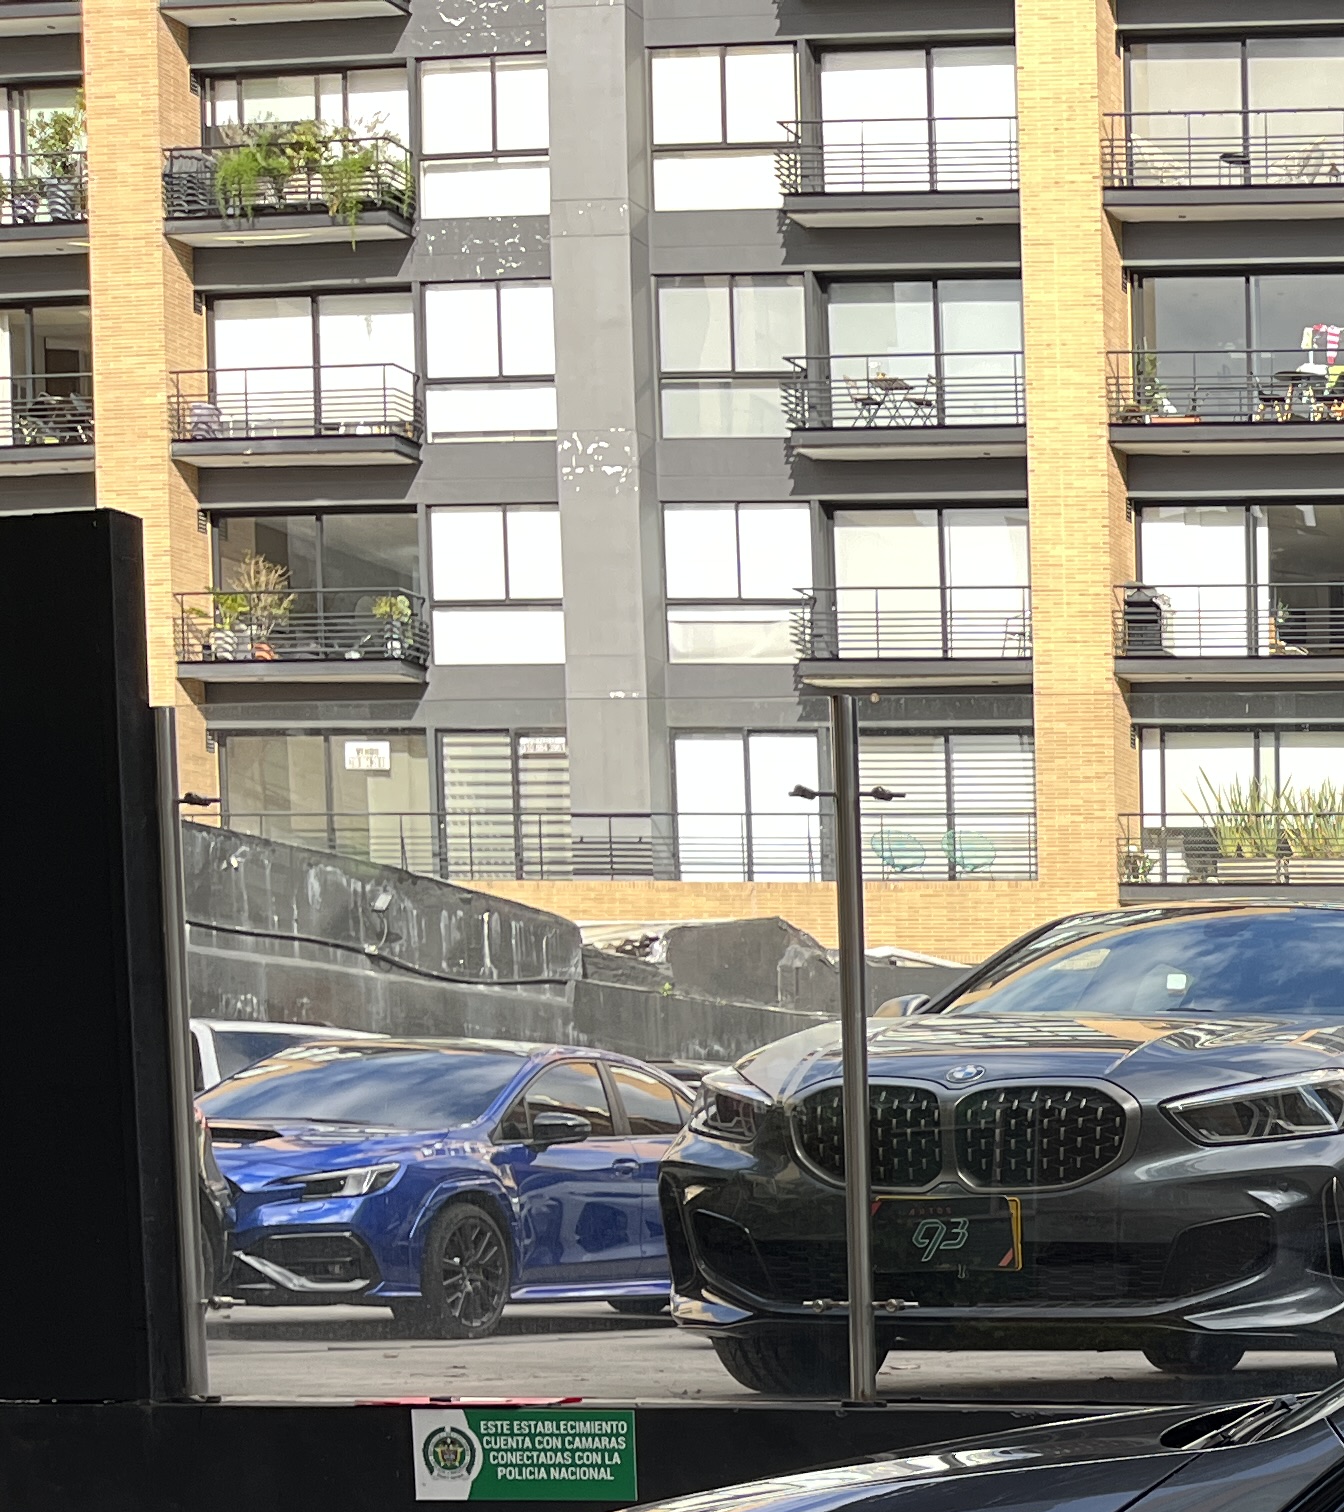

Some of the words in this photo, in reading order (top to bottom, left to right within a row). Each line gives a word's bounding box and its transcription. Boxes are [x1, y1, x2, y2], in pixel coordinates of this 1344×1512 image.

[911, 1217, 970, 1263] 93
[480, 1420, 511, 1434] ESTE
[513, 1420, 628, 1434] ESTABLECIMIENTO
[482, 1436, 532, 1449] CUENTA
[534, 1436, 562, 1449] CON
[564, 1436, 626, 1449] CAMARAS
[489, 1451, 572, 1465] CONECTADAS
[575, 1452, 602, 1465] CON
[604, 1452, 621, 1465] LA
[497, 1466, 547, 1480] POLICIA
[550, 1466, 615, 1480] NACIONAL
